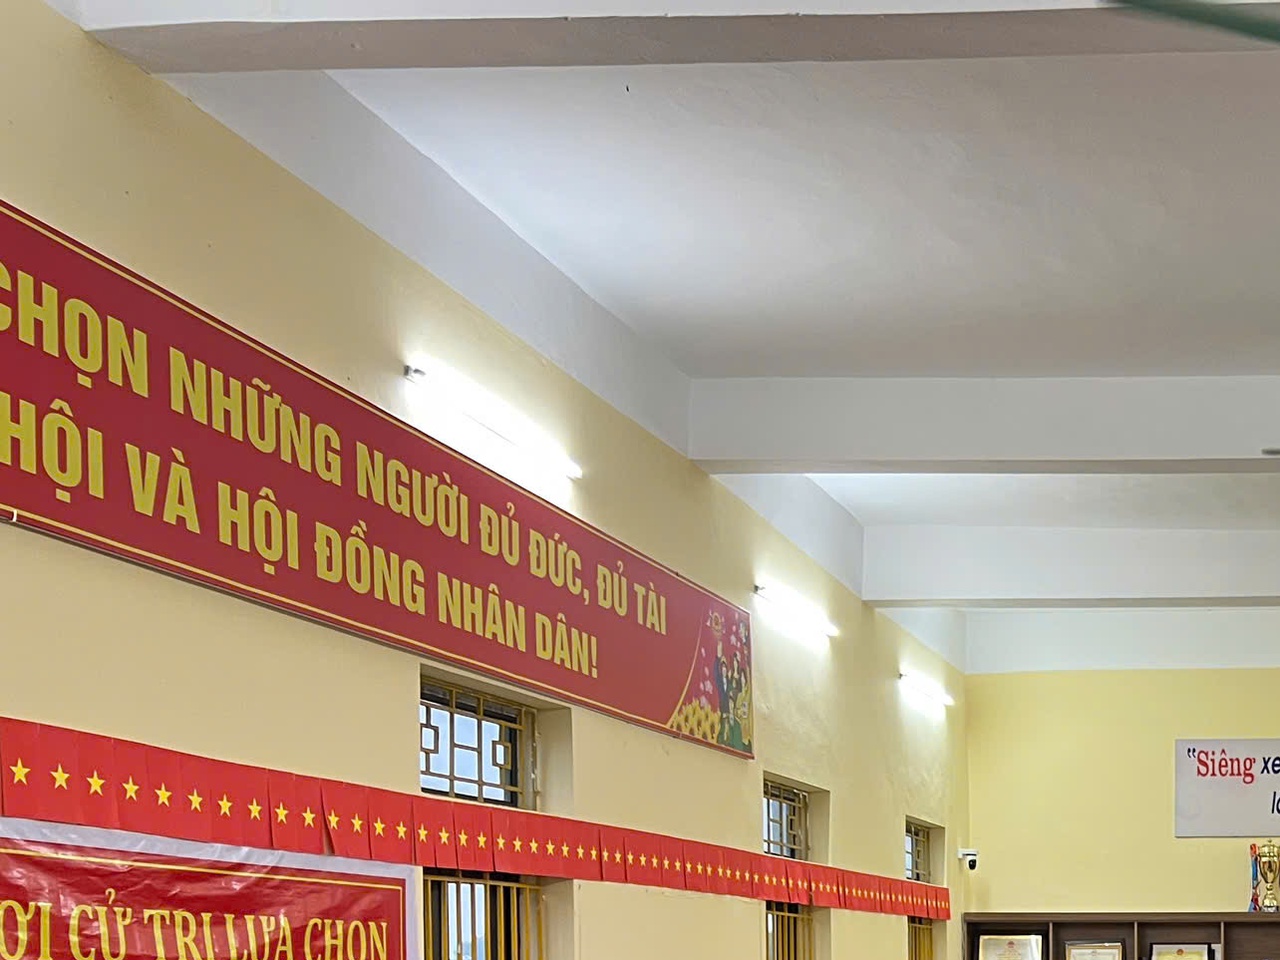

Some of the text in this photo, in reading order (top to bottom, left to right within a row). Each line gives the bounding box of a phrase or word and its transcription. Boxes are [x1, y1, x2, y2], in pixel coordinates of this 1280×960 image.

[0, 391, 598, 679] HỘI VÀ HỘI ĐỒNG NHÂN DÂN!
[169, 346, 341, 487] NHỮNG
[356, 441, 469, 545] NGƯỜI
[480, 502, 520, 566] ĐỦ
[528, 532, 590, 605] ĐỨC,
[596, 560, 627, 616] ĐỦ
[633, 582, 667, 635] TÀI
